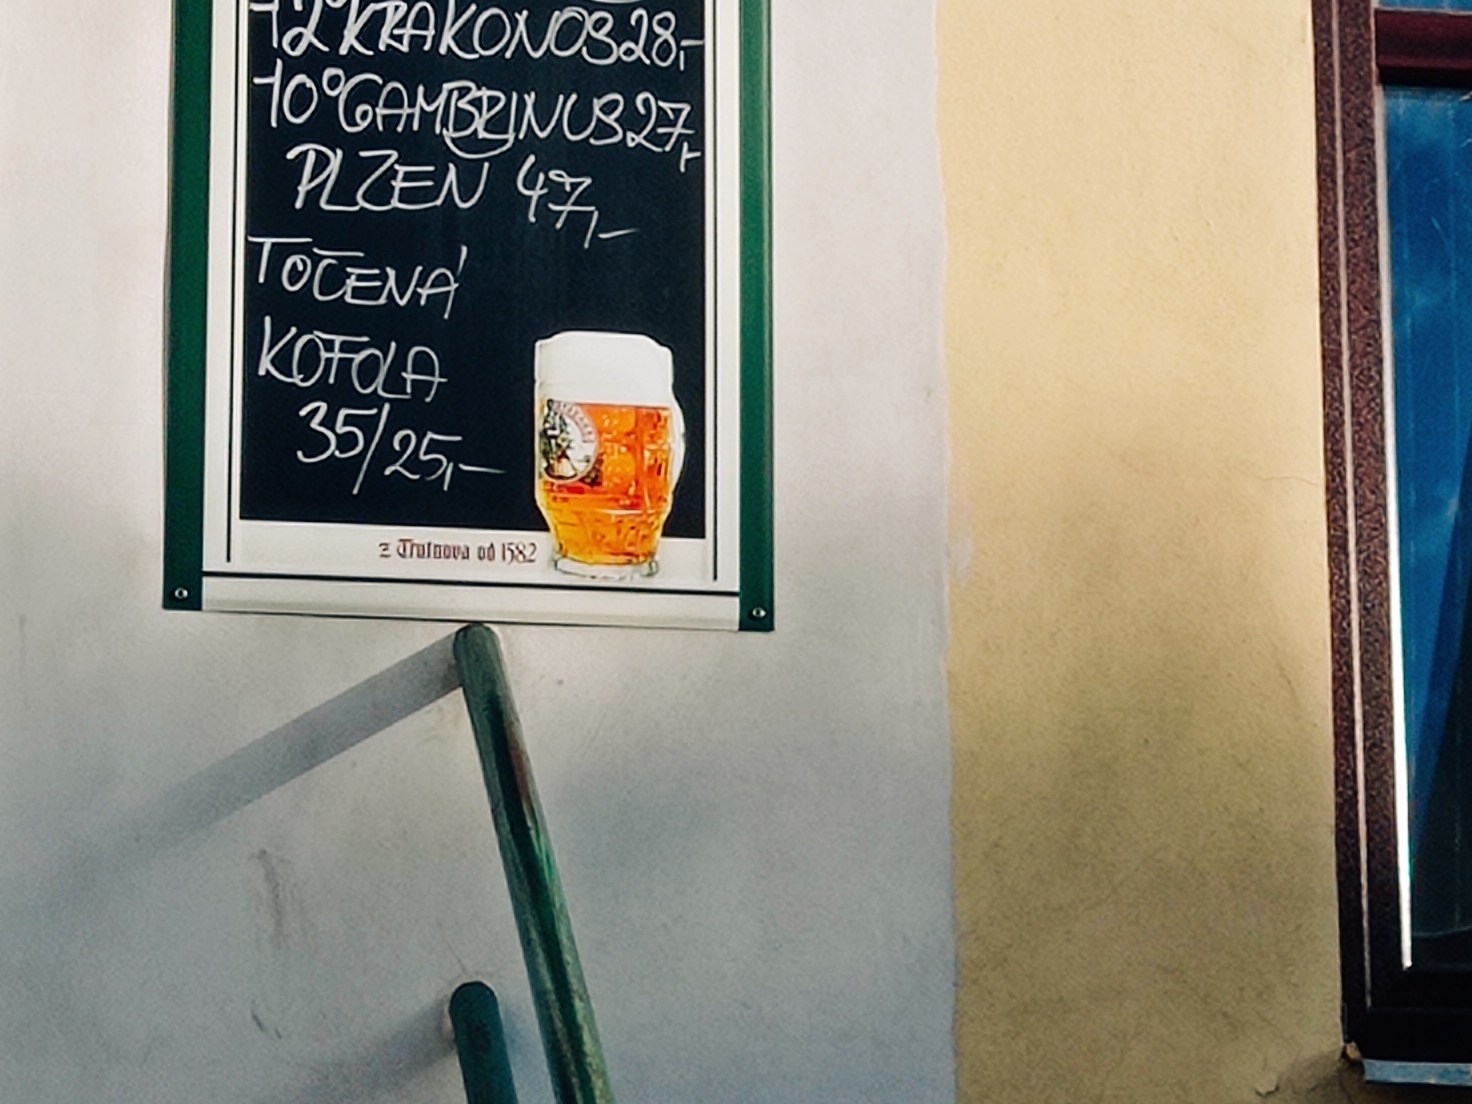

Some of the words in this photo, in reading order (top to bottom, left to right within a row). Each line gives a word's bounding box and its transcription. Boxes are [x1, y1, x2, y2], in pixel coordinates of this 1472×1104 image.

[257, 315, 448, 402] KOFOLA
[378, 542, 391, 558] z
[396, 538, 470, 561] Trutnova
[477, 541, 496, 561] od
[501, 542, 538, 564] 1582
